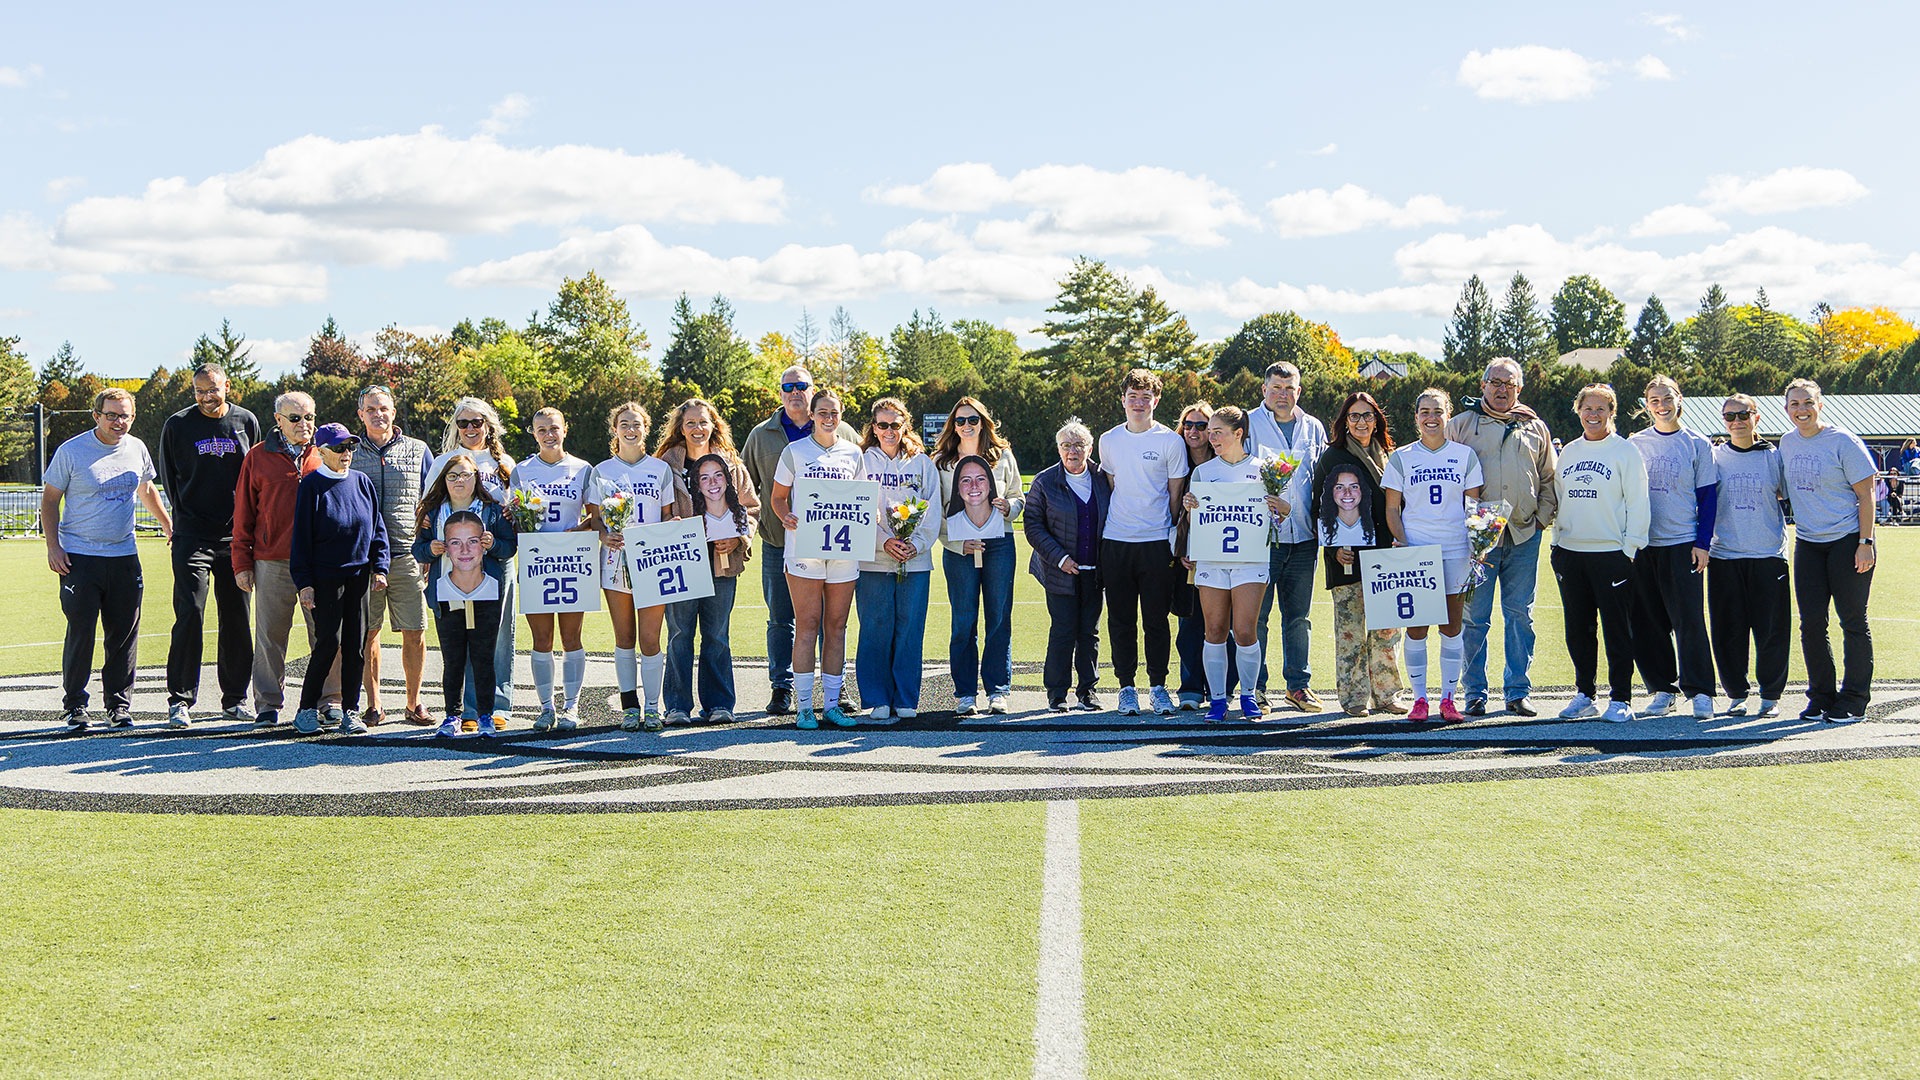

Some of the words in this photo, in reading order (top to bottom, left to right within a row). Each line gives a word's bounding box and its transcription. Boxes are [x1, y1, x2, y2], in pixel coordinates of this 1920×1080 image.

[198, 442, 236, 455] SOCCER
[1562, 464, 1574, 479] ST.
[1574, 460, 1612, 480] MICHAEL'S
[1410, 474, 1461, 486] MICHAELS
[1429, 484, 1442, 505] 8
[1568, 489, 1598, 499] SOCCER
[813, 502, 863, 511] SAINT
[1205, 504, 1256, 513] SAINT
[806, 510, 870, 526] MICHAELS
[1199, 512, 1264, 527] MICHAELS
[821, 524, 851, 552] 14
[1222, 526, 1239, 553] 2
[641, 542, 691, 558] SAINT
[534, 555, 584, 564] SAINT
[635, 548, 701, 572] MICHAELS
[527, 562, 593, 579] MICHAELS
[1377, 569, 1427, 580] SAINT
[657, 565, 689, 596] 21
[1370, 576, 1437, 595] MICHAELS
[542, 576, 578, 605] 25
[1396, 591, 1415, 620] 8
